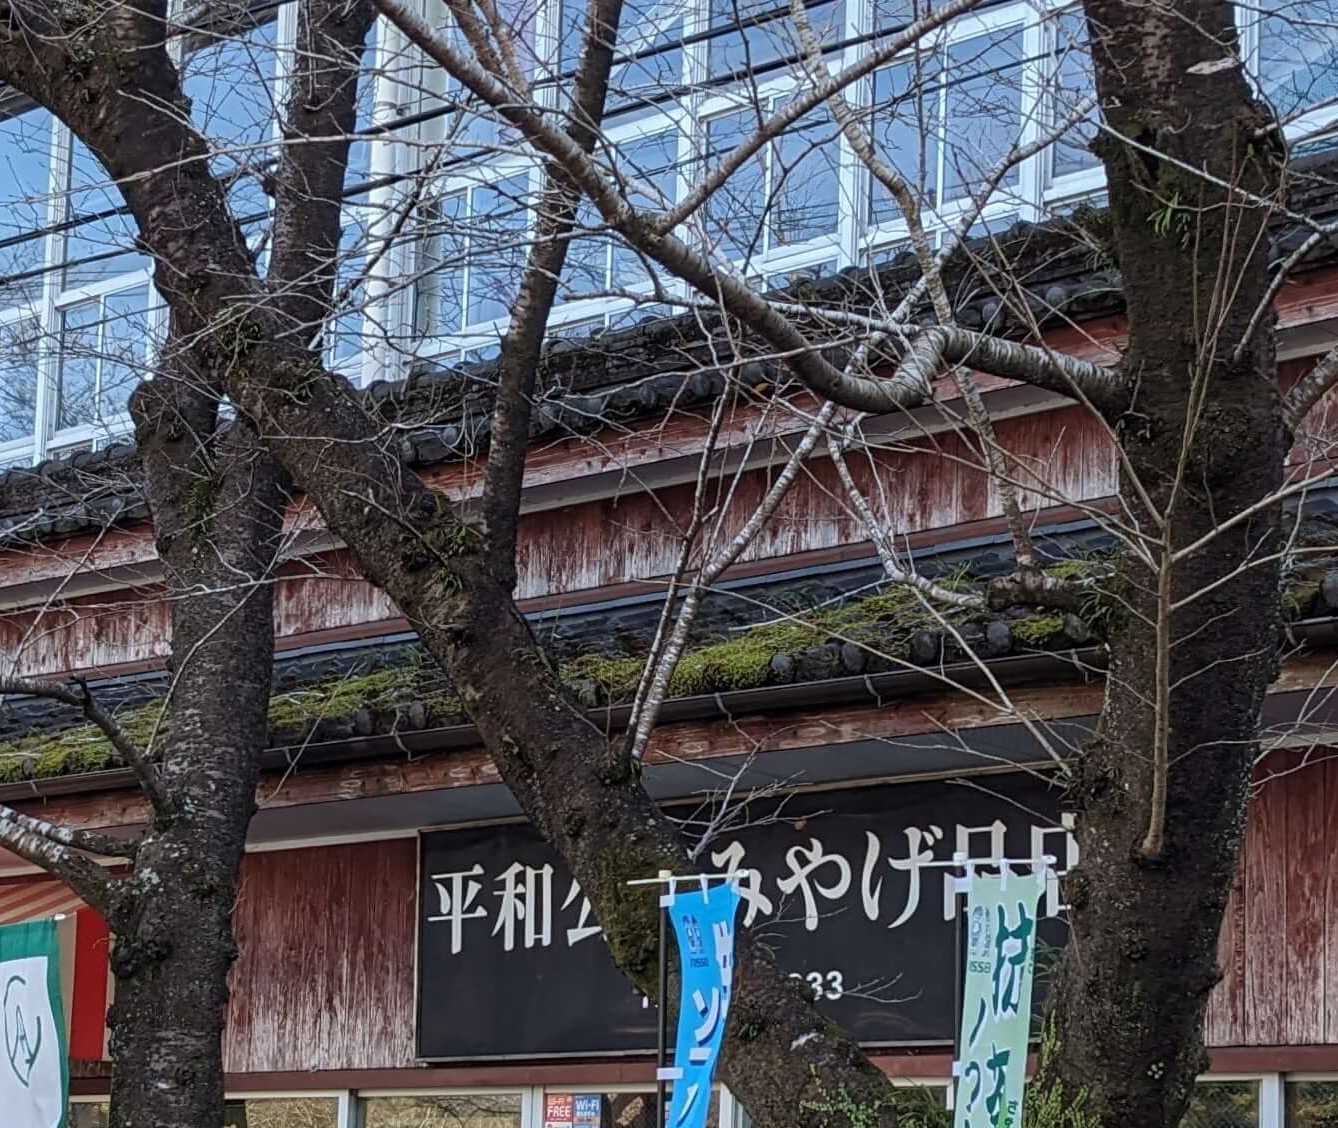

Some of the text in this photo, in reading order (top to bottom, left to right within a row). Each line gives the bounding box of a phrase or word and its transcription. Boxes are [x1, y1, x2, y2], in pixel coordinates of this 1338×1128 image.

[428, 812, 1080, 955] 平和公みやげ品
[547, 1105, 571, 1118] FREE
